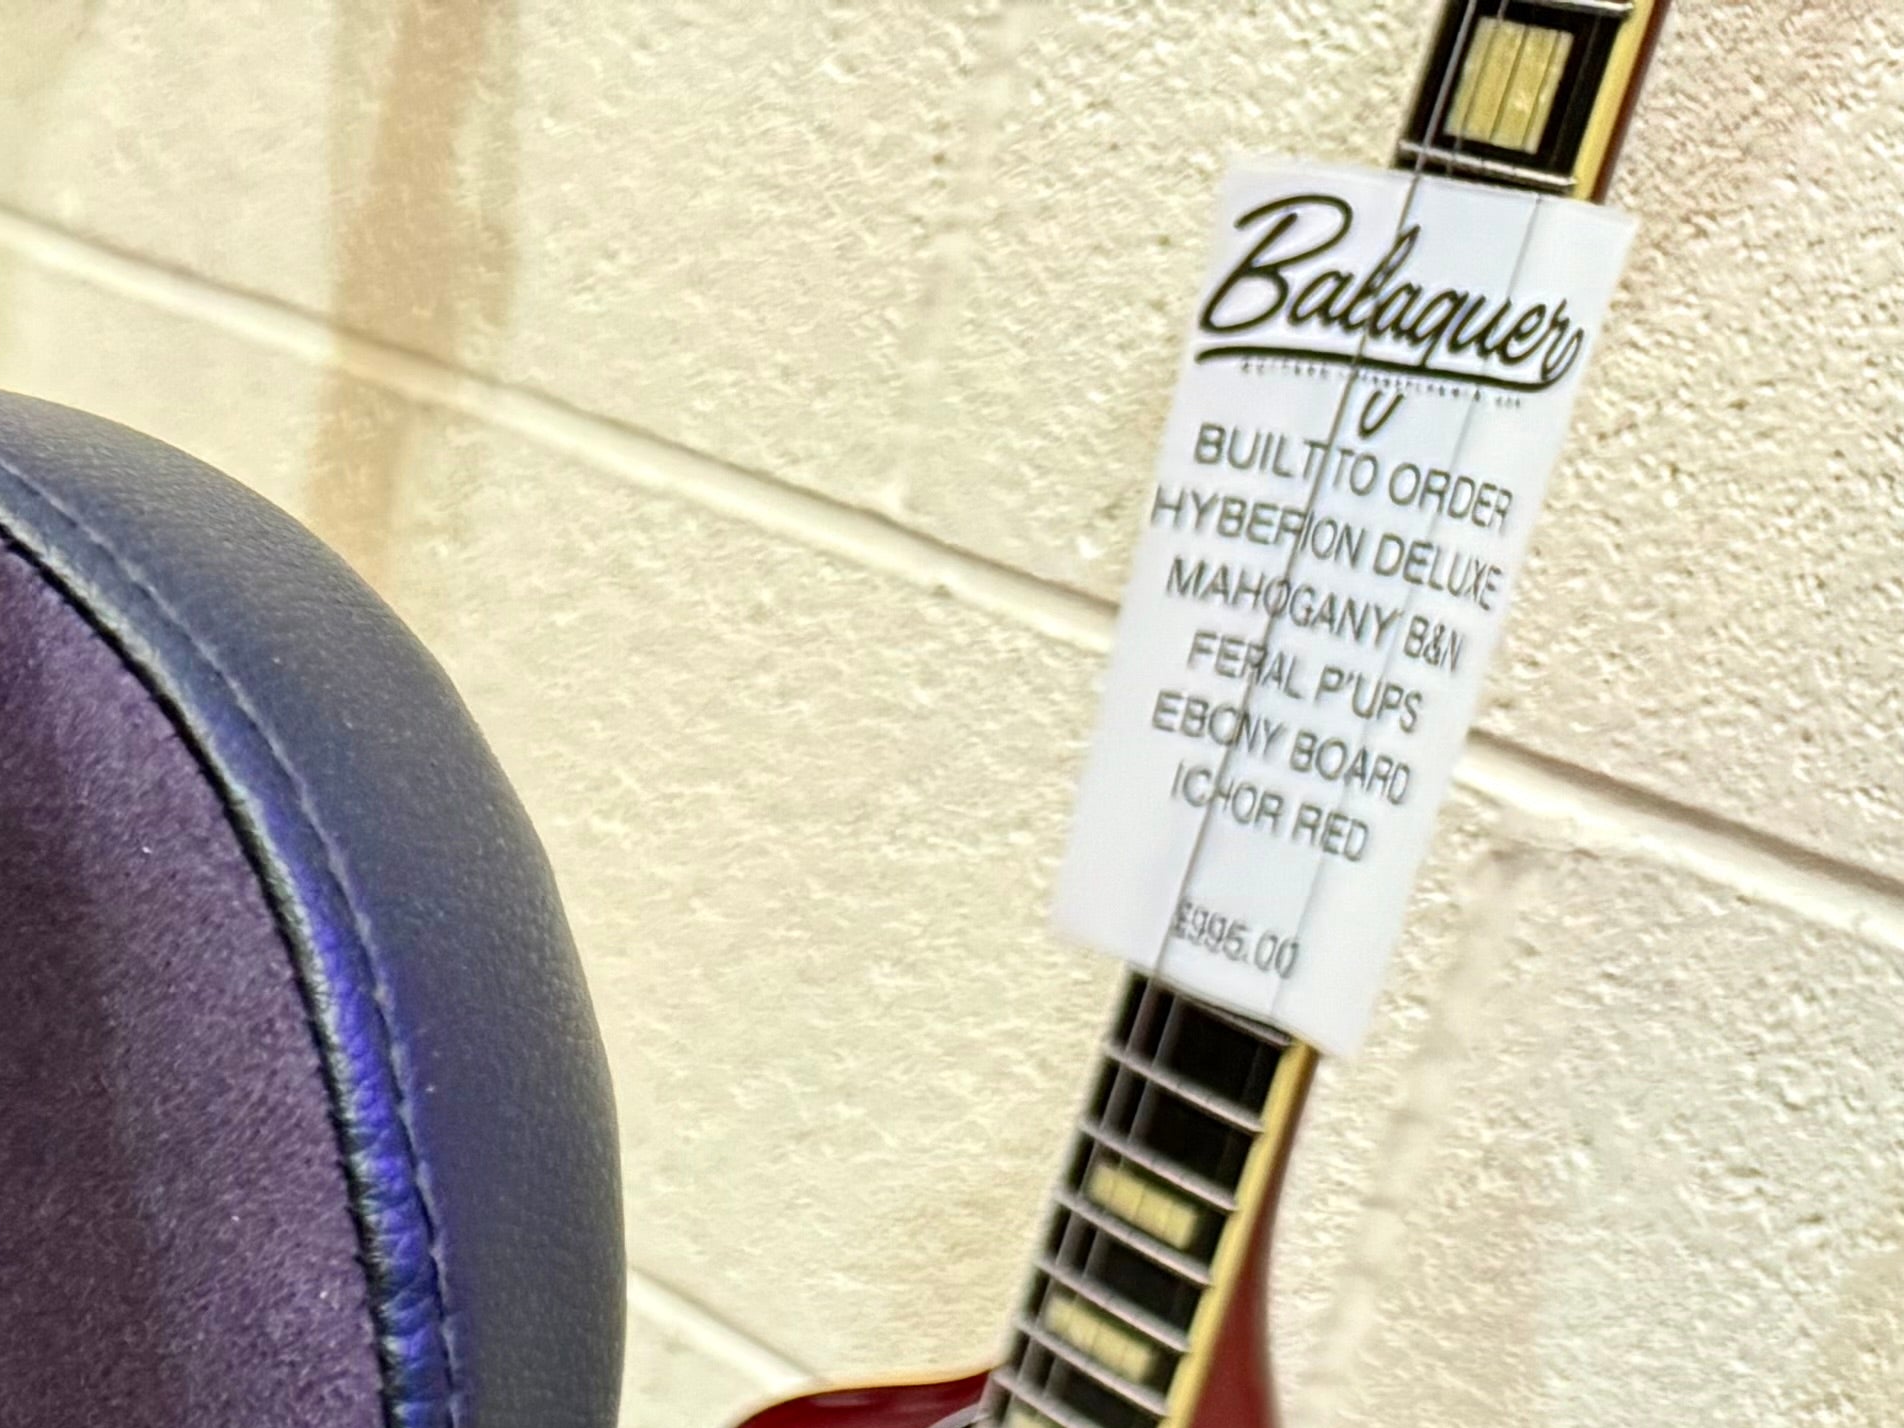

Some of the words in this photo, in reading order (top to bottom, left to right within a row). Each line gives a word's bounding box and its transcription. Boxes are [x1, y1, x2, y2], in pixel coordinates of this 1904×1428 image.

[1197, 194, 1584, 438] Balaguer
[1194, 422, 1330, 480] BUILT
[1332, 447, 1379, 497] TO
[1388, 462, 1513, 534] ORDER
[1165, 555, 1404, 647] MAHOGANY
[1402, 614, 1465, 673] B&N
[1372, 533, 1503, 611] DELUXE
[1187, 629, 1303, 701] FERAL
[1313, 664, 1423, 734] P'UPS
[1151, 689, 1287, 757] EBONY
[1289, 729, 1411, 806] BOARD
[1170, 758, 1285, 836] ICHOR
[1291, 802, 1370, 862] RED
